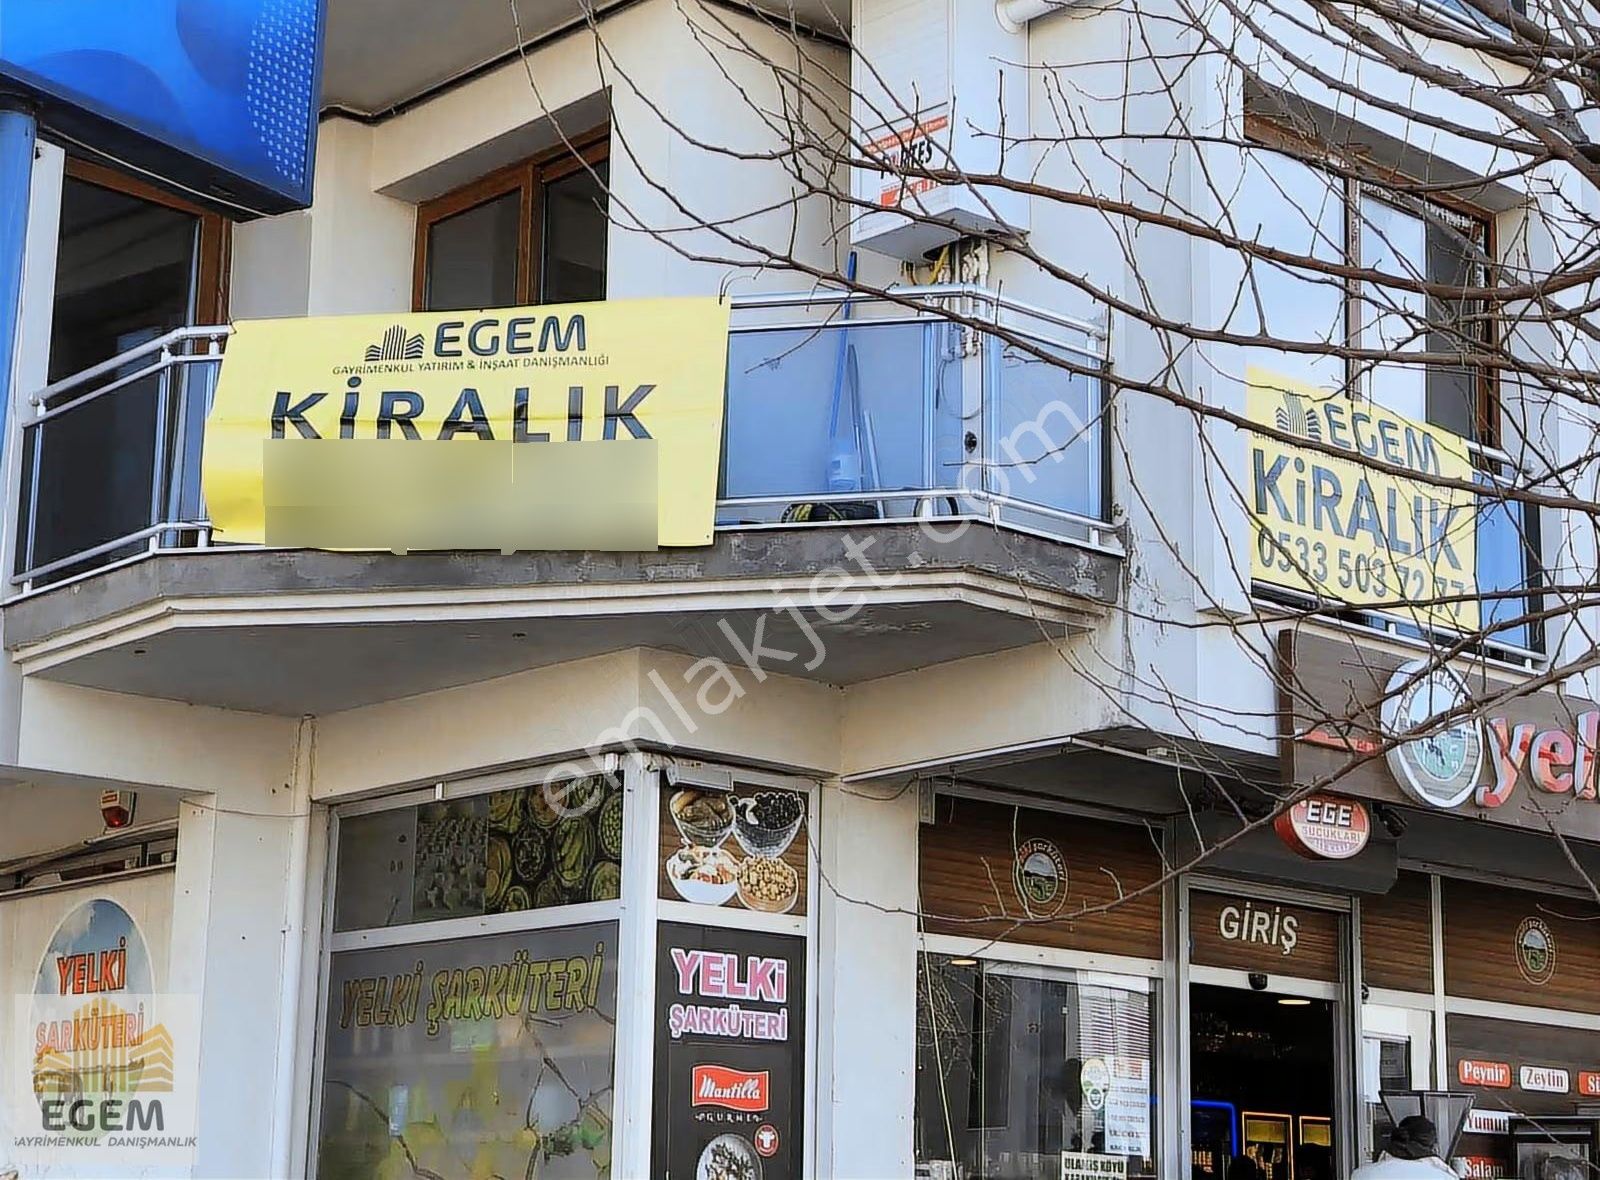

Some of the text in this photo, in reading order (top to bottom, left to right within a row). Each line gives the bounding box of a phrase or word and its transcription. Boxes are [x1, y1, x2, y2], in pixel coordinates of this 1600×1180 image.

[433, 314, 588, 357] EGEM
[332, 353, 610, 376] GAYRİMENKUL YATIRIM & İNŞAAT DANIŞMANLIĞI
[270, 375, 658, 443] KİRALIK
[1258, 527, 1465, 617] 0533 503 72 77
[1475, 709, 1600, 808] yel
[1306, 800, 1352, 828] EGE
[1220, 901, 1298, 955] GİRİŞ
[56, 936, 127, 996] YELKİ
[339, 940, 605, 1036] YELKİ ŞARKÜTERİ
[35, 1002, 146, 1064] ŞARKÜTERİ
[669, 1003, 788, 1041] ŞARKÜTERİ
[699, 1074, 761, 1100] Mantilla
[1463, 1060, 1507, 1085] Peynir
[1526, 1069, 1564, 1089] Zeytin
[1466, 1159, 1504, 1178] Salam
